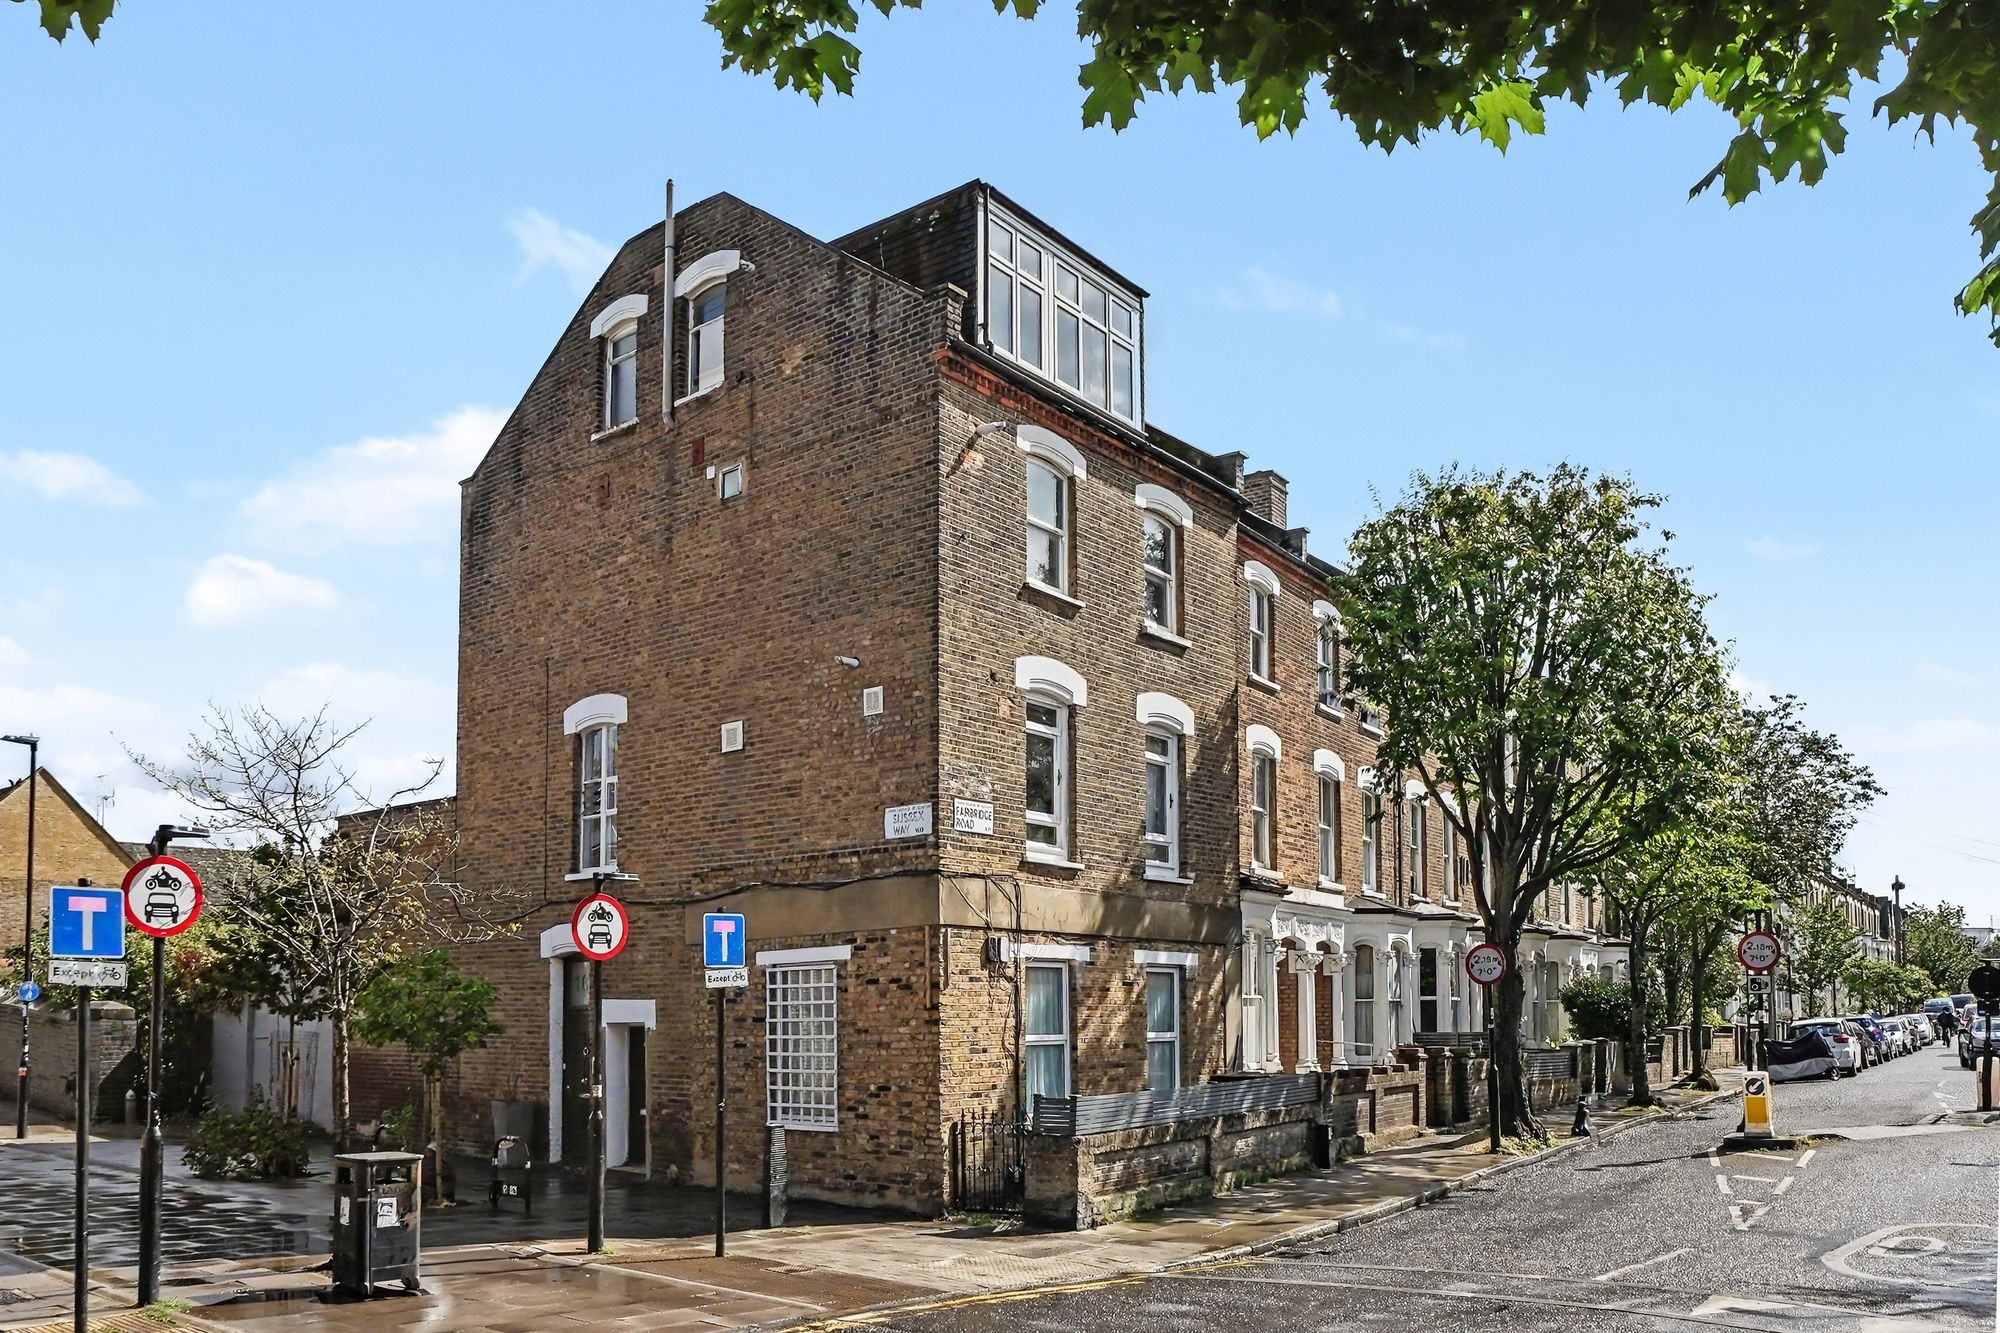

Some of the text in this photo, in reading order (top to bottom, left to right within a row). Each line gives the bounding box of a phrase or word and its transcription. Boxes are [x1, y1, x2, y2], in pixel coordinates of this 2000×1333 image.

[893, 811, 924, 824] SUSSEX
[893, 825, 910, 835] WAY
[956, 818, 975, 830] ROAD
[53, 967, 94, 980] Except
[708, 975, 730, 983] Except
